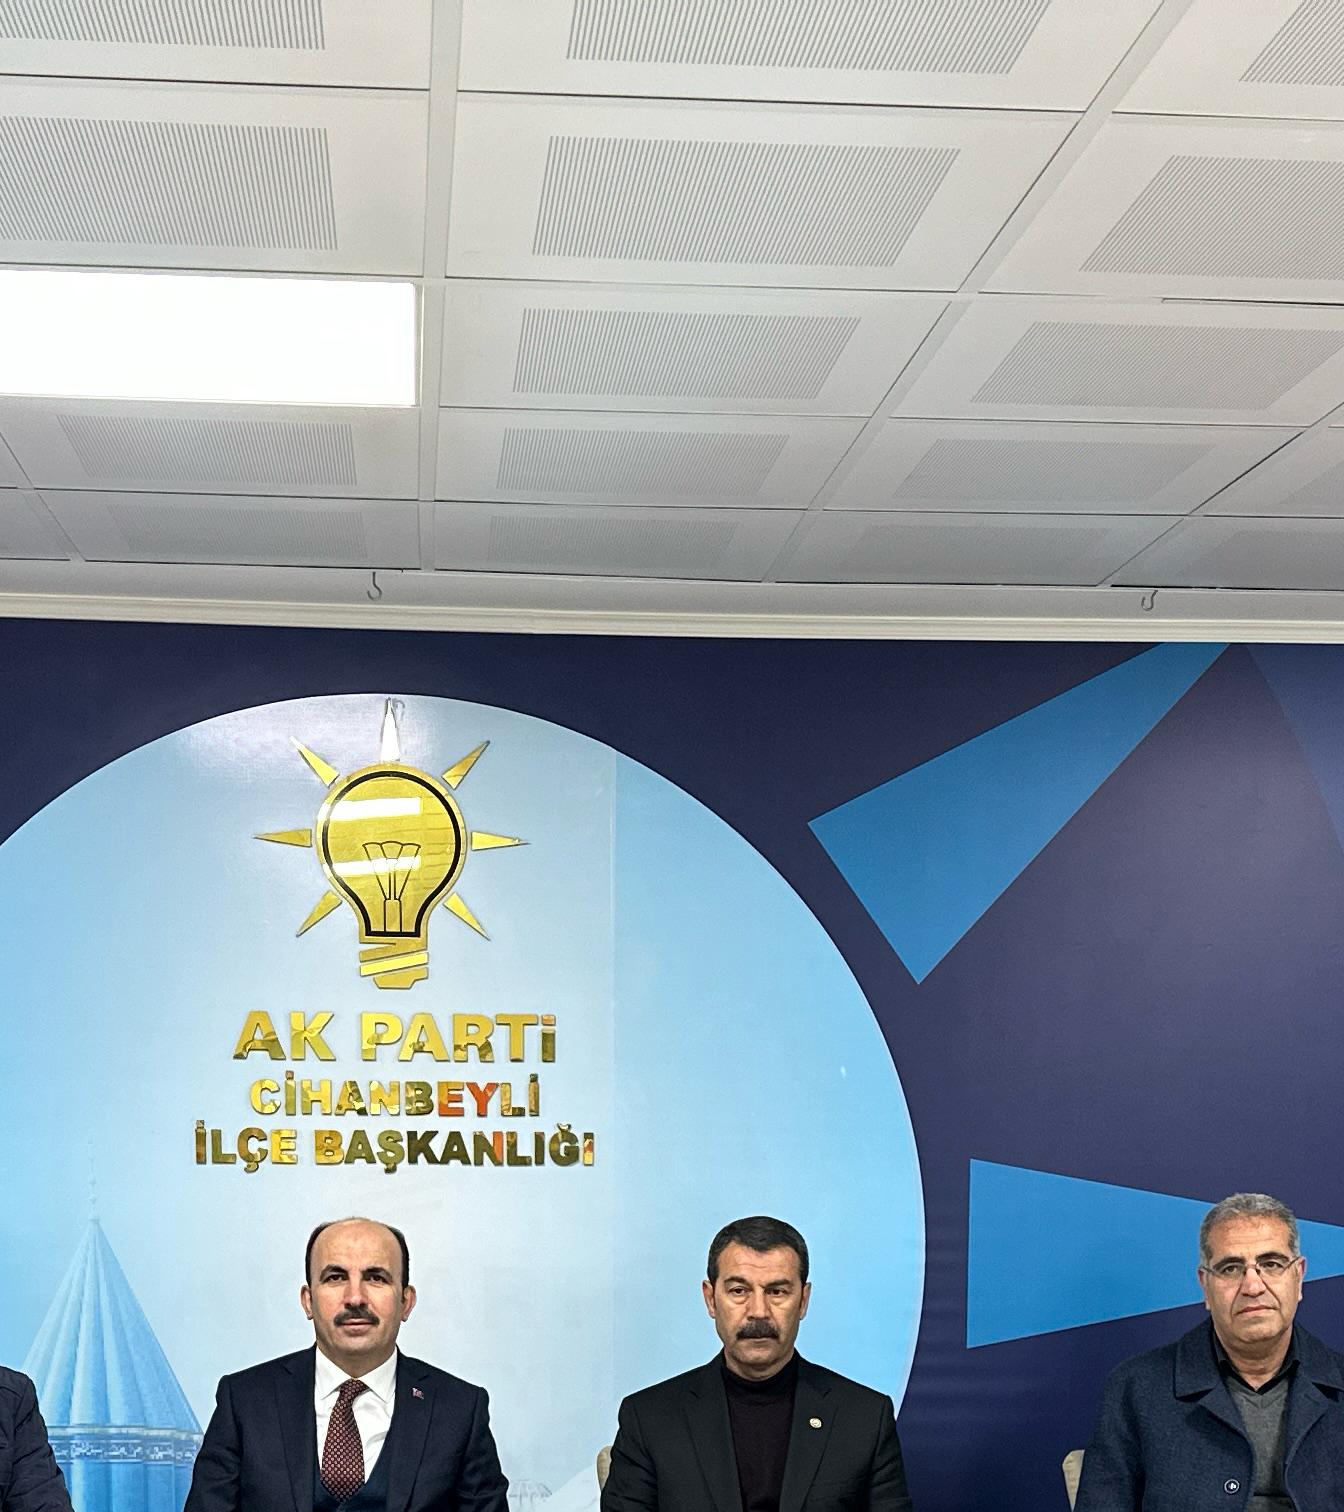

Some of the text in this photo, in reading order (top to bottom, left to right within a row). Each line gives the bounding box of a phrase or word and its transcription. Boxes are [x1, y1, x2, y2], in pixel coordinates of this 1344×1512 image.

[233, 1010, 336, 1062] AK
[250, 1070, 540, 1116] CİHANBEYLİ
[195, 1120, 594, 1173] İLÇE BAŞKANLIĞI
